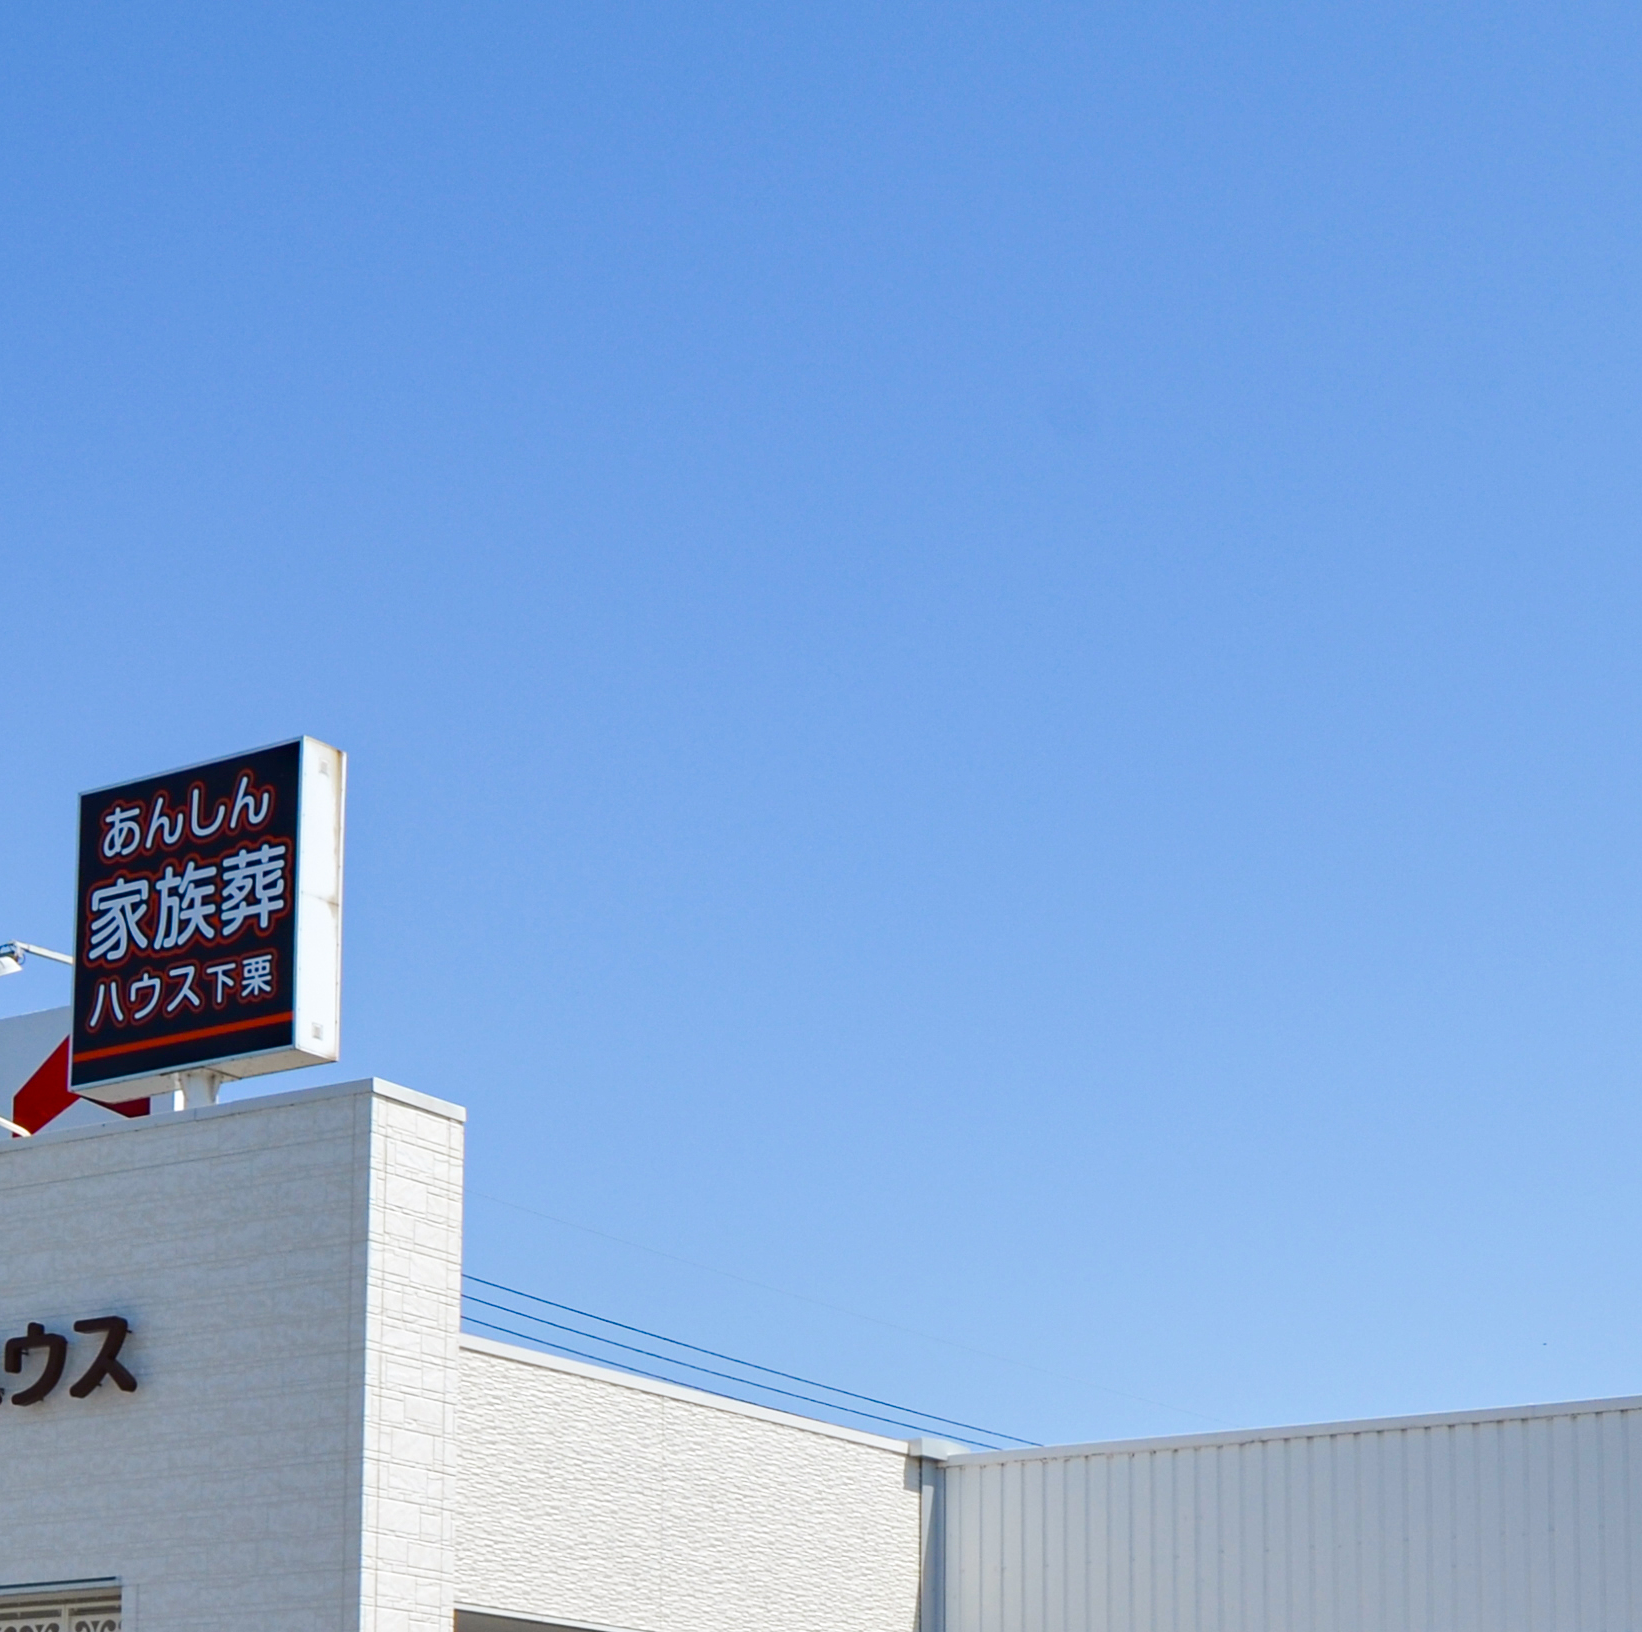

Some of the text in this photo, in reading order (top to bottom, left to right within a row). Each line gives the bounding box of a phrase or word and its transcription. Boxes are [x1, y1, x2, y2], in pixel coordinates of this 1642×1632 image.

[102, 775, 270, 858] あんしん
[87, 843, 286, 961] 家族葬
[88, 953, 273, 1028] ハウス下栗
